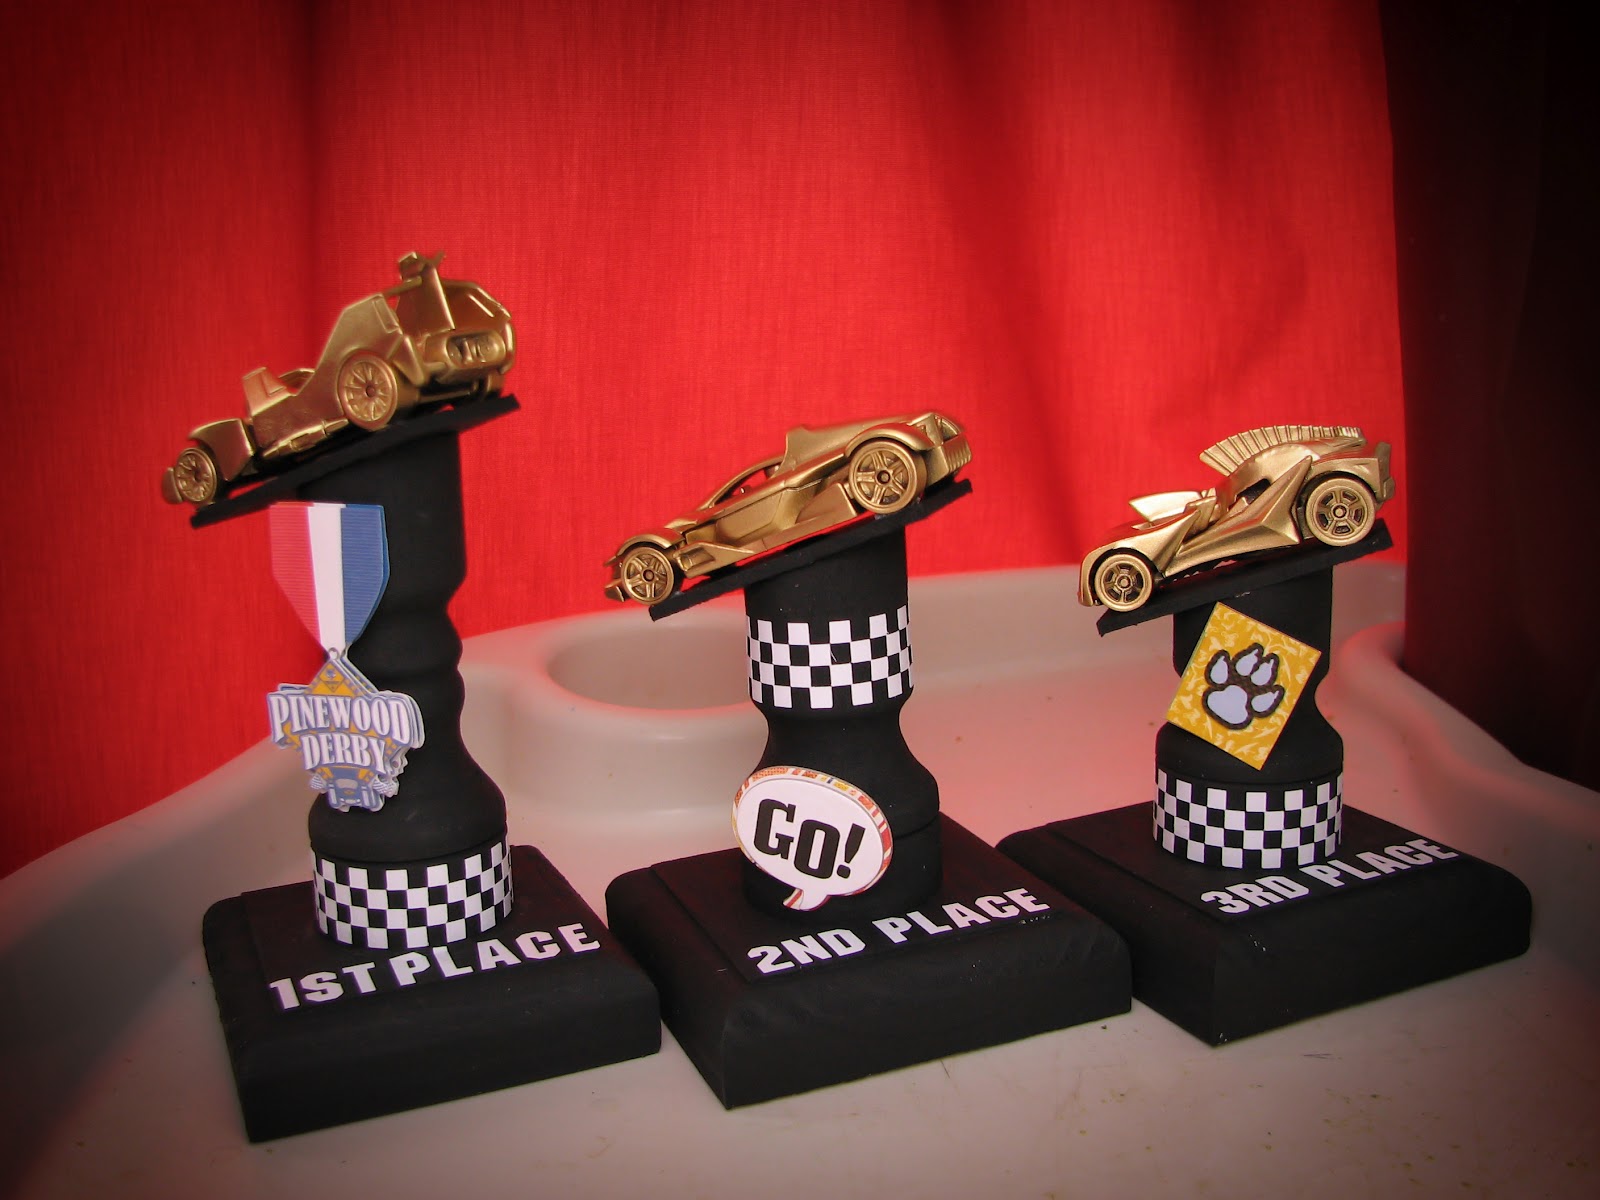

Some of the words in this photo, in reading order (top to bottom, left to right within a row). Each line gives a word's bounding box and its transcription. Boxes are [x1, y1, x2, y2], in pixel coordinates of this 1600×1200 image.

[269, 694, 411, 745] PINEWOOD
[301, 732, 387, 775] DERBY
[753, 798, 865, 879] GO!
[1201, 876, 1309, 914] 3RD
[1299, 839, 1459, 888] PLACE
[269, 962, 377, 1010] 1ST
[389, 923, 600, 986] PLACE
[747, 928, 866, 974] 2ND
[872, 888, 1050, 944] PLACE
